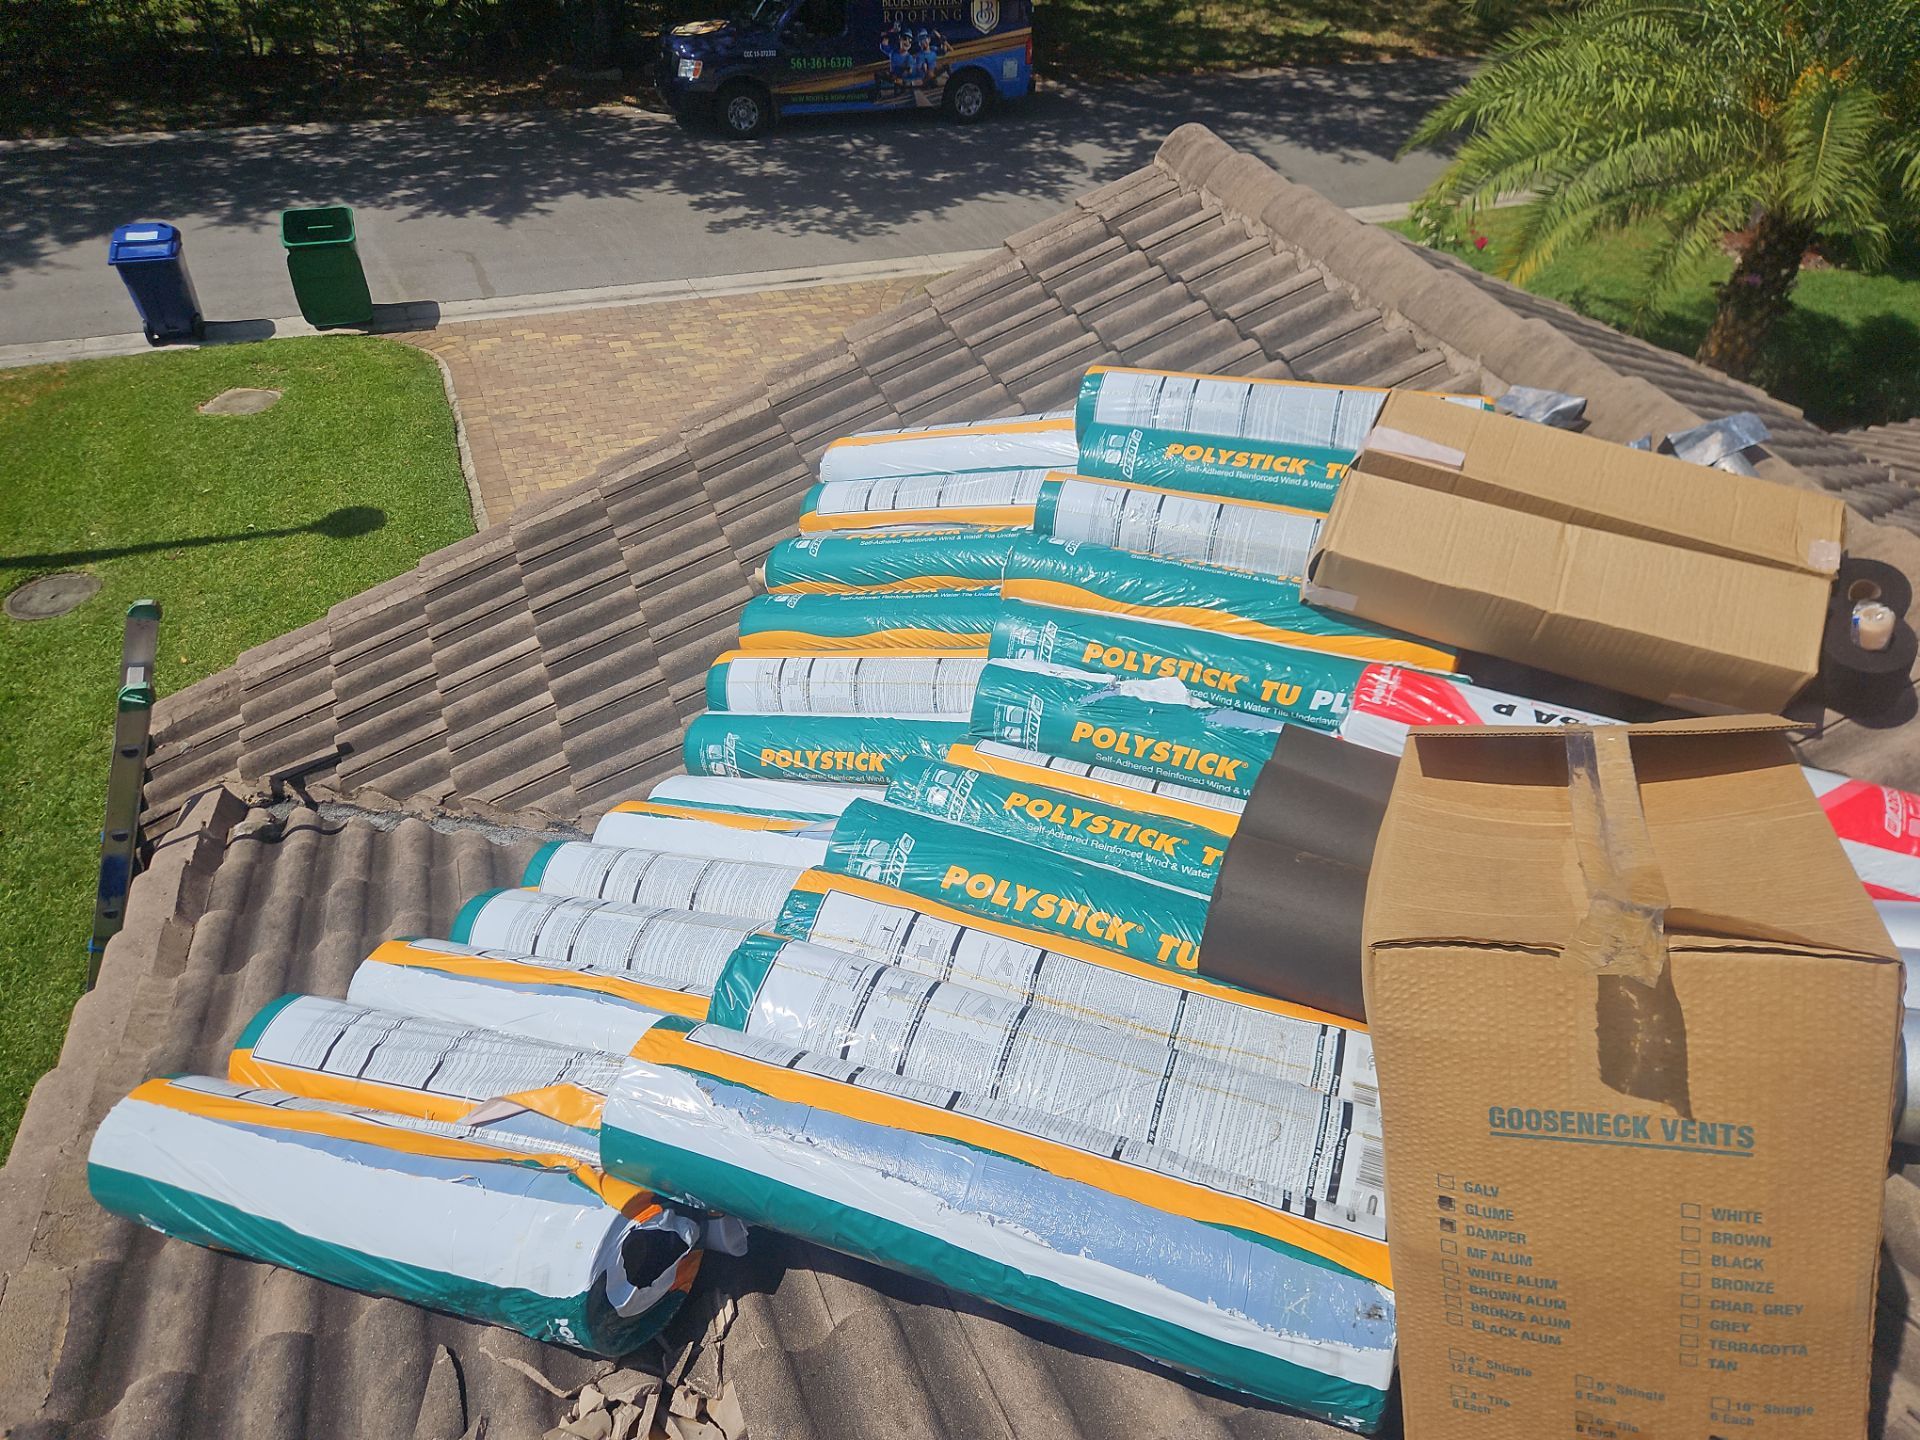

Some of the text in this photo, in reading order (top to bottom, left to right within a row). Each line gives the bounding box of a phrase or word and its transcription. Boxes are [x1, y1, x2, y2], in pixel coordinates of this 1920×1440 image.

[883, 9, 962, 23] ROOFING
[1235, 470, 1279, 484] Reinforced
[1280, 475, 1301, 486] Wind
[1310, 480, 1335, 490] Water
[1261, 679, 1302, 706] TU
[1210, 692, 1233, 706] Wind
[1234, 699, 1242, 709] &
[1243, 702, 1270, 714] Water
[1095, 752, 1154, 773] Self-Adhered
[1156, 767, 1206, 786] Reinforced
[1207, 779, 1231, 793] Wind
[1233, 785, 1241, 795] &
[1027, 822, 1212, 880] Self-Adhered Reinforced Wind & Water
[1488, 1105, 1755, 1149] GOOSENECK VENTS
[1464, 1181, 1499, 1197] GALV
[1465, 1203, 1515, 1221] GLUME
[1711, 1207, 1763, 1224] WHITE
[1465, 1225, 1526, 1244] DAMPER
[1711, 1231, 1772, 1249] BROWN
[1466, 1246, 1533, 1267] MF ALUM
[1711, 1254, 1765, 1271] BLACK
[1467, 1266, 1559, 1290] WHITE ALUM
[1711, 1277, 1776, 1295] BRONZE
[1468, 1284, 1567, 1310] BROWN ALUM
[1470, 1302, 1571, 1329] BRONZE ALUM
[1763, 1303, 1804, 1316] GREY
[1471, 1319, 1562, 1345] BLACK ALUM
[1709, 1319, 1751, 1333] GREY
[1709, 1339, 1809, 1357] TERRACOTTA
[1468, 1366, 1496, 1381] Each
[1486, 1359, 1533, 1377] Shingle
[1708, 1358, 1739, 1371] TAN
[1616, 1384, 1665, 1402] Shingle
[1723, 1414, 1755, 1426] Each
[1763, 1404, 1815, 1418] Shingle
